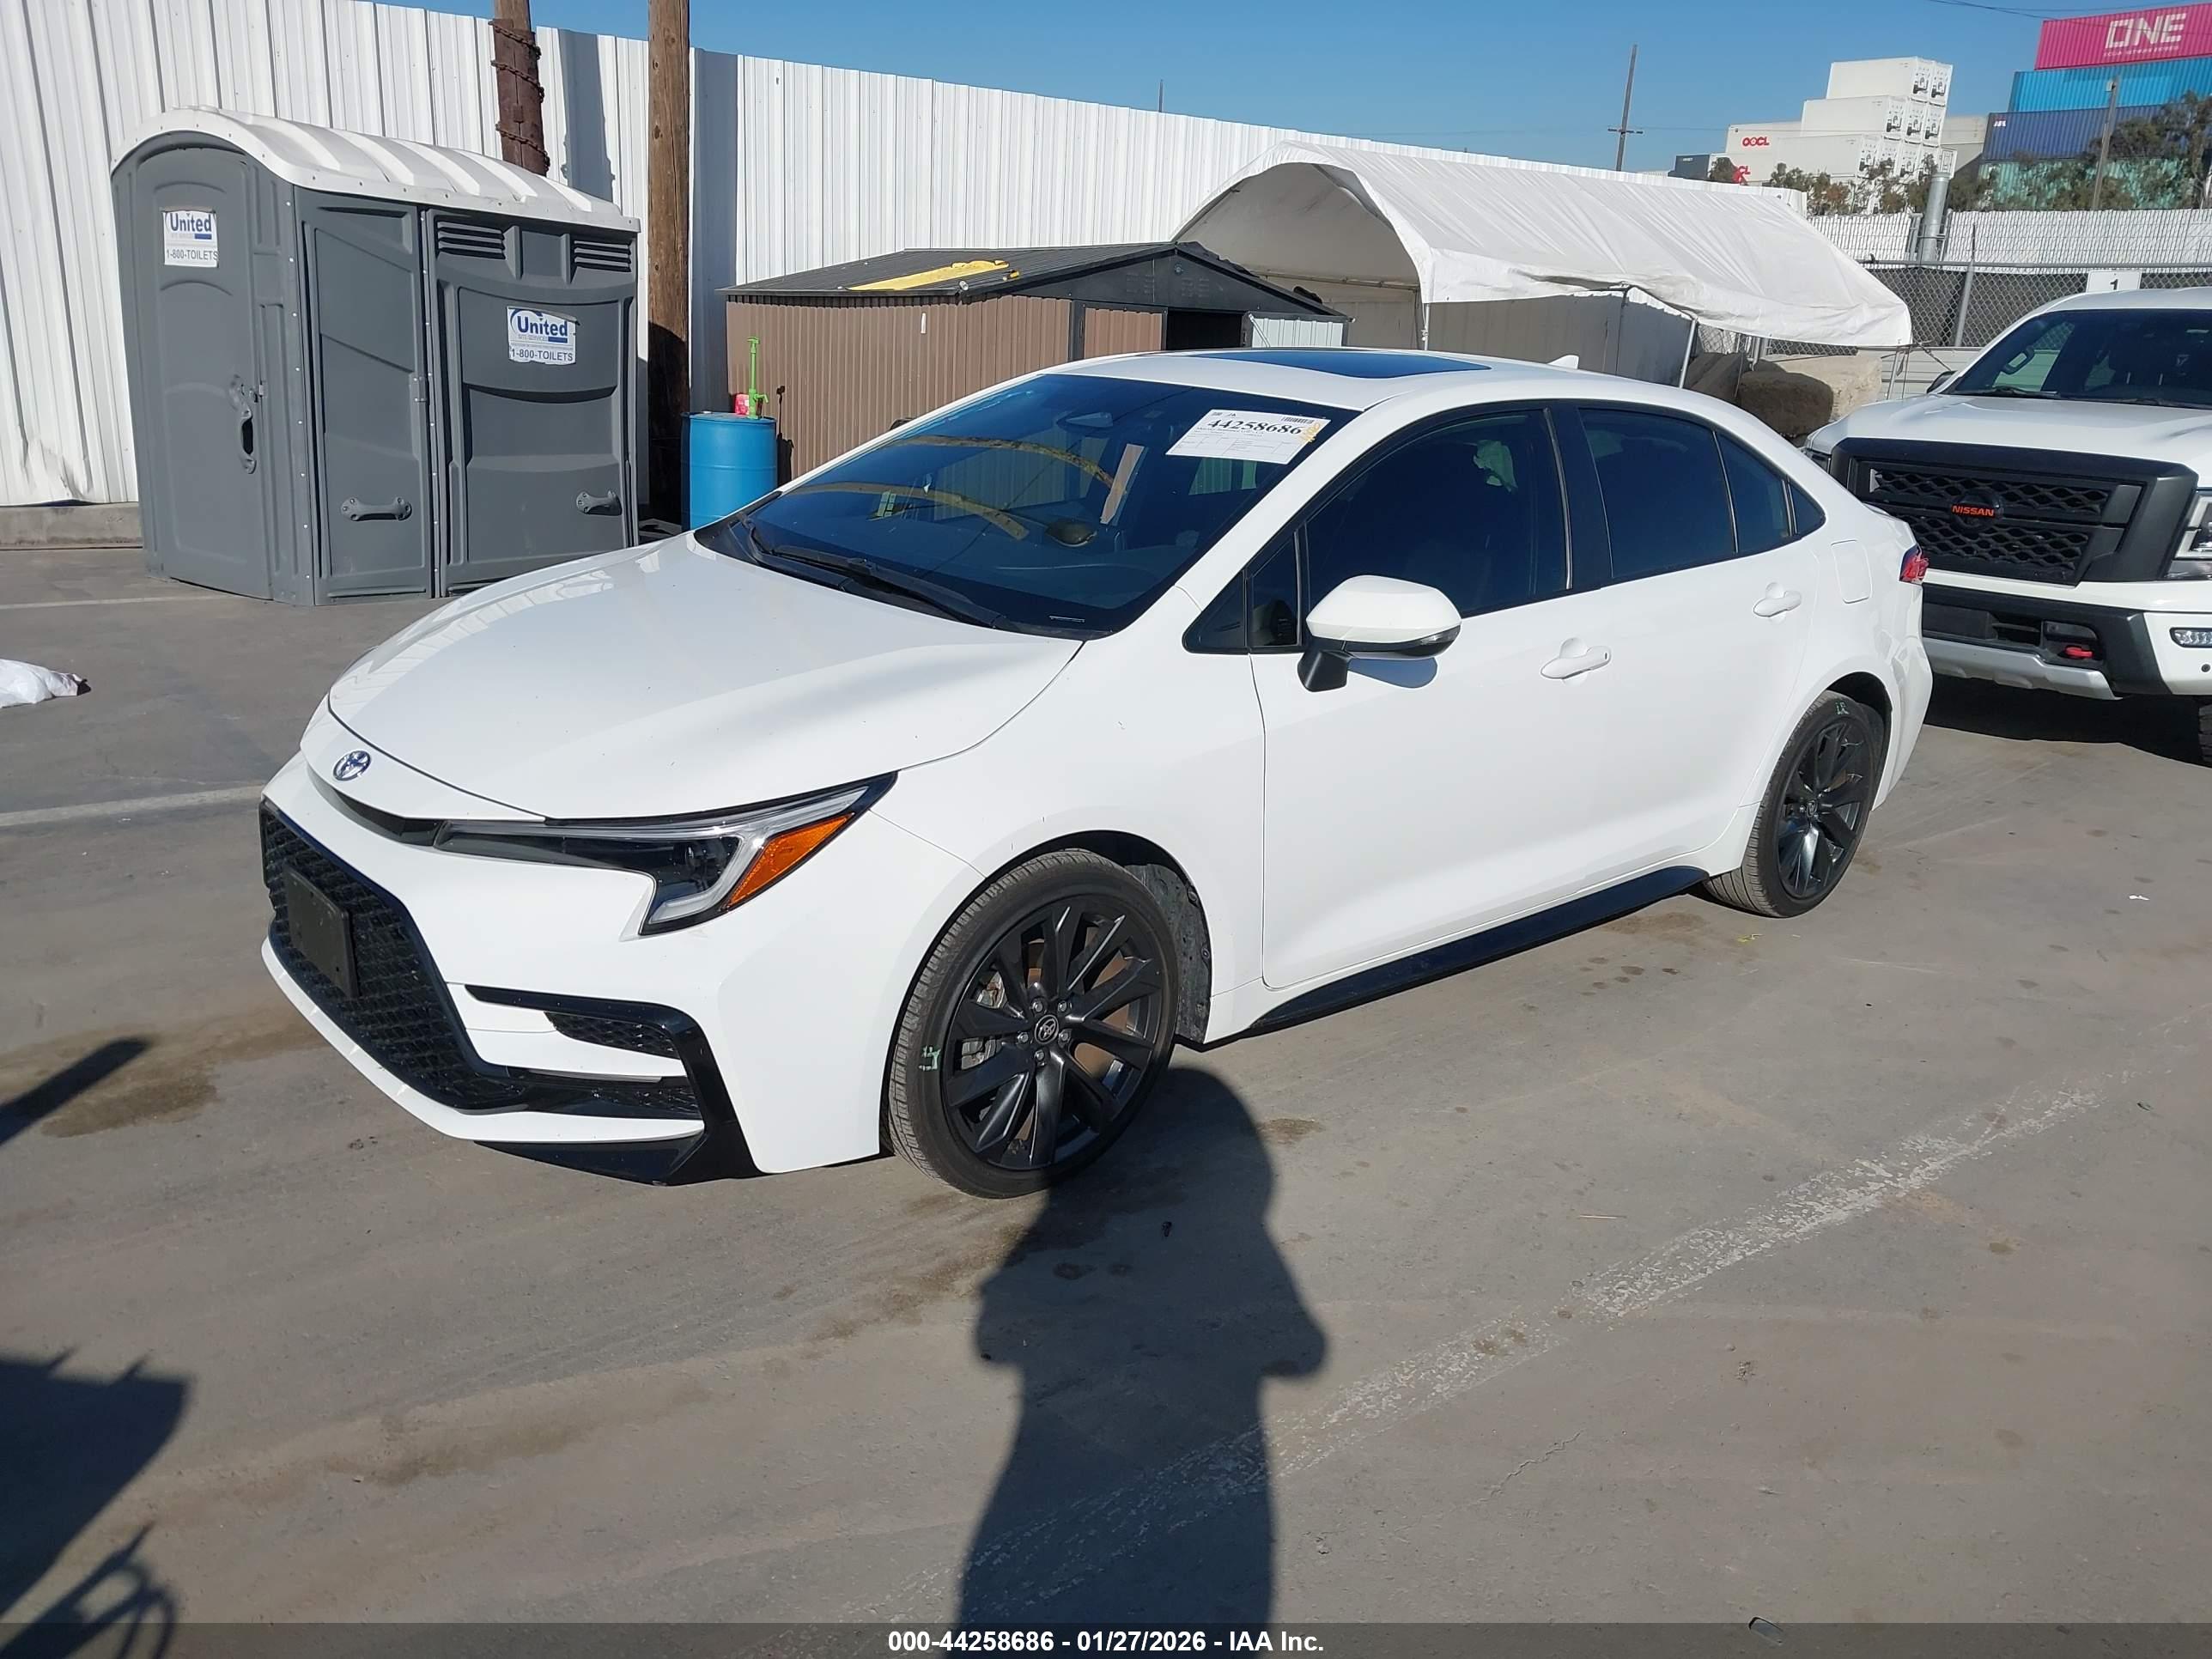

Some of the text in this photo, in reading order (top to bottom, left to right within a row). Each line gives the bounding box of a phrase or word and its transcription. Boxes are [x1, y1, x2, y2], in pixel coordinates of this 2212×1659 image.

[2105, 13, 2187, 49] ONE
[1742, 137, 1770, 146] OOCL
[169, 212, 212, 233] United
[167, 249, 219, 260] 1-800-TOILETS
[2110, 278, 2118, 290] 1
[517, 315, 568, 337] United
[511, 349, 574, 362] 1-800-TOILETS
[1207, 419, 1306, 434] 44258686
[1952, 505, 1995, 517] NISSAN
